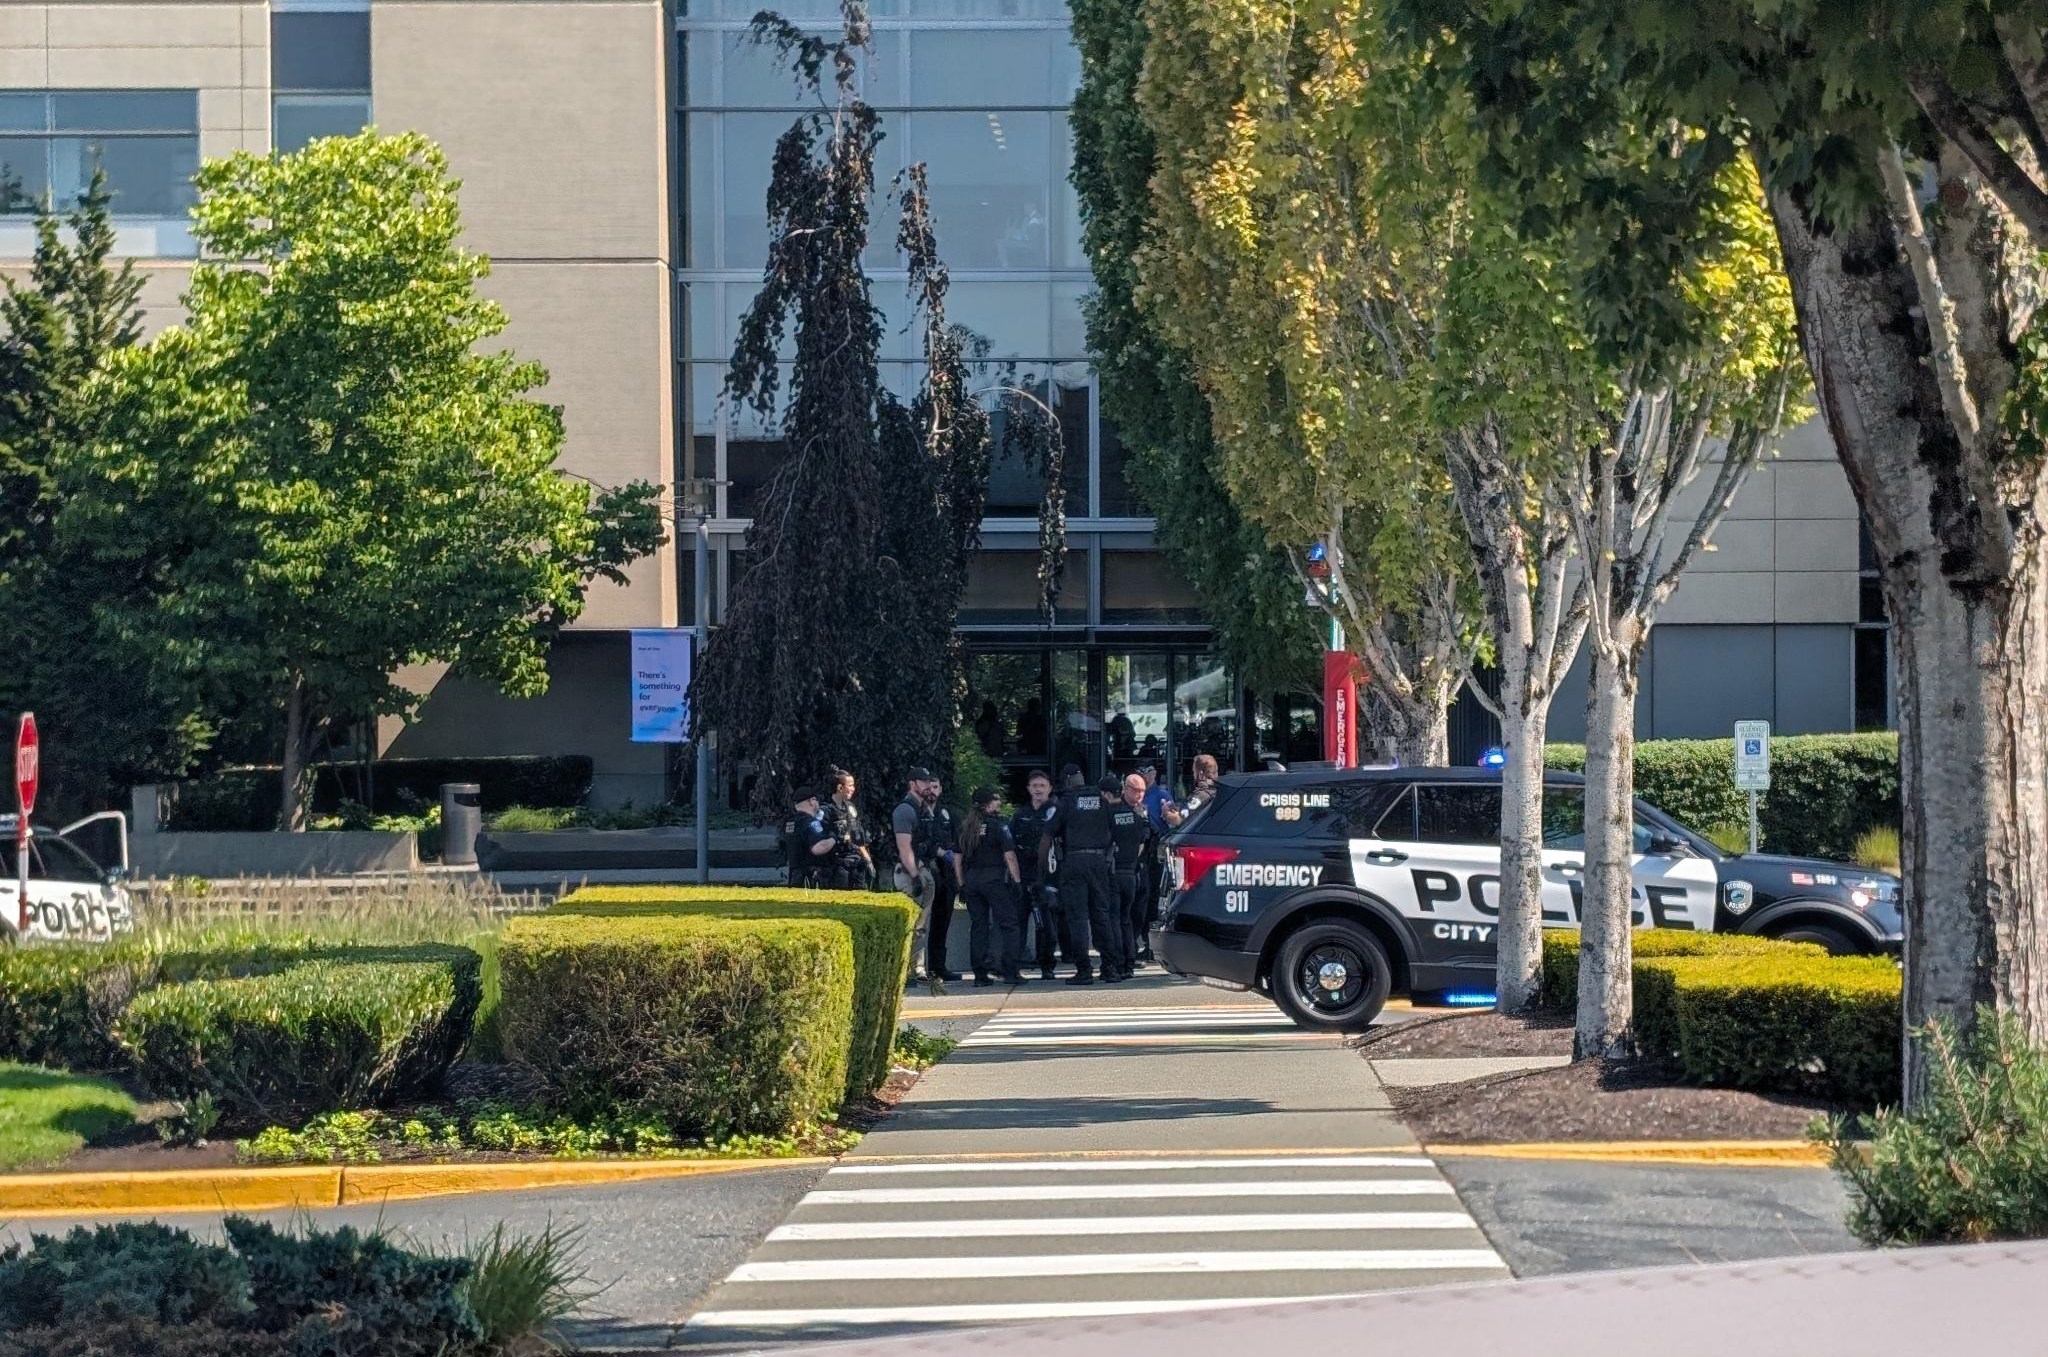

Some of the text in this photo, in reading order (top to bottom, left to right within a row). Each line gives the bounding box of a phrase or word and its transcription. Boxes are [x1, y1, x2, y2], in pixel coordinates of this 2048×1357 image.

[638, 670, 666, 679] There's
[639, 682, 681, 692] something
[639, 692, 651, 701] for
[1077, 800, 1101, 810] POLICE
[1260, 794, 1330, 807] CRISIS LINE
[1115, 816, 1135, 825] POLICE
[1216, 864, 1323, 887] EMERGENCY
[1226, 890, 1249, 913] 911
[1728, 901, 1746, 909] POLICE
[1434, 923, 1492, 942] CITY
